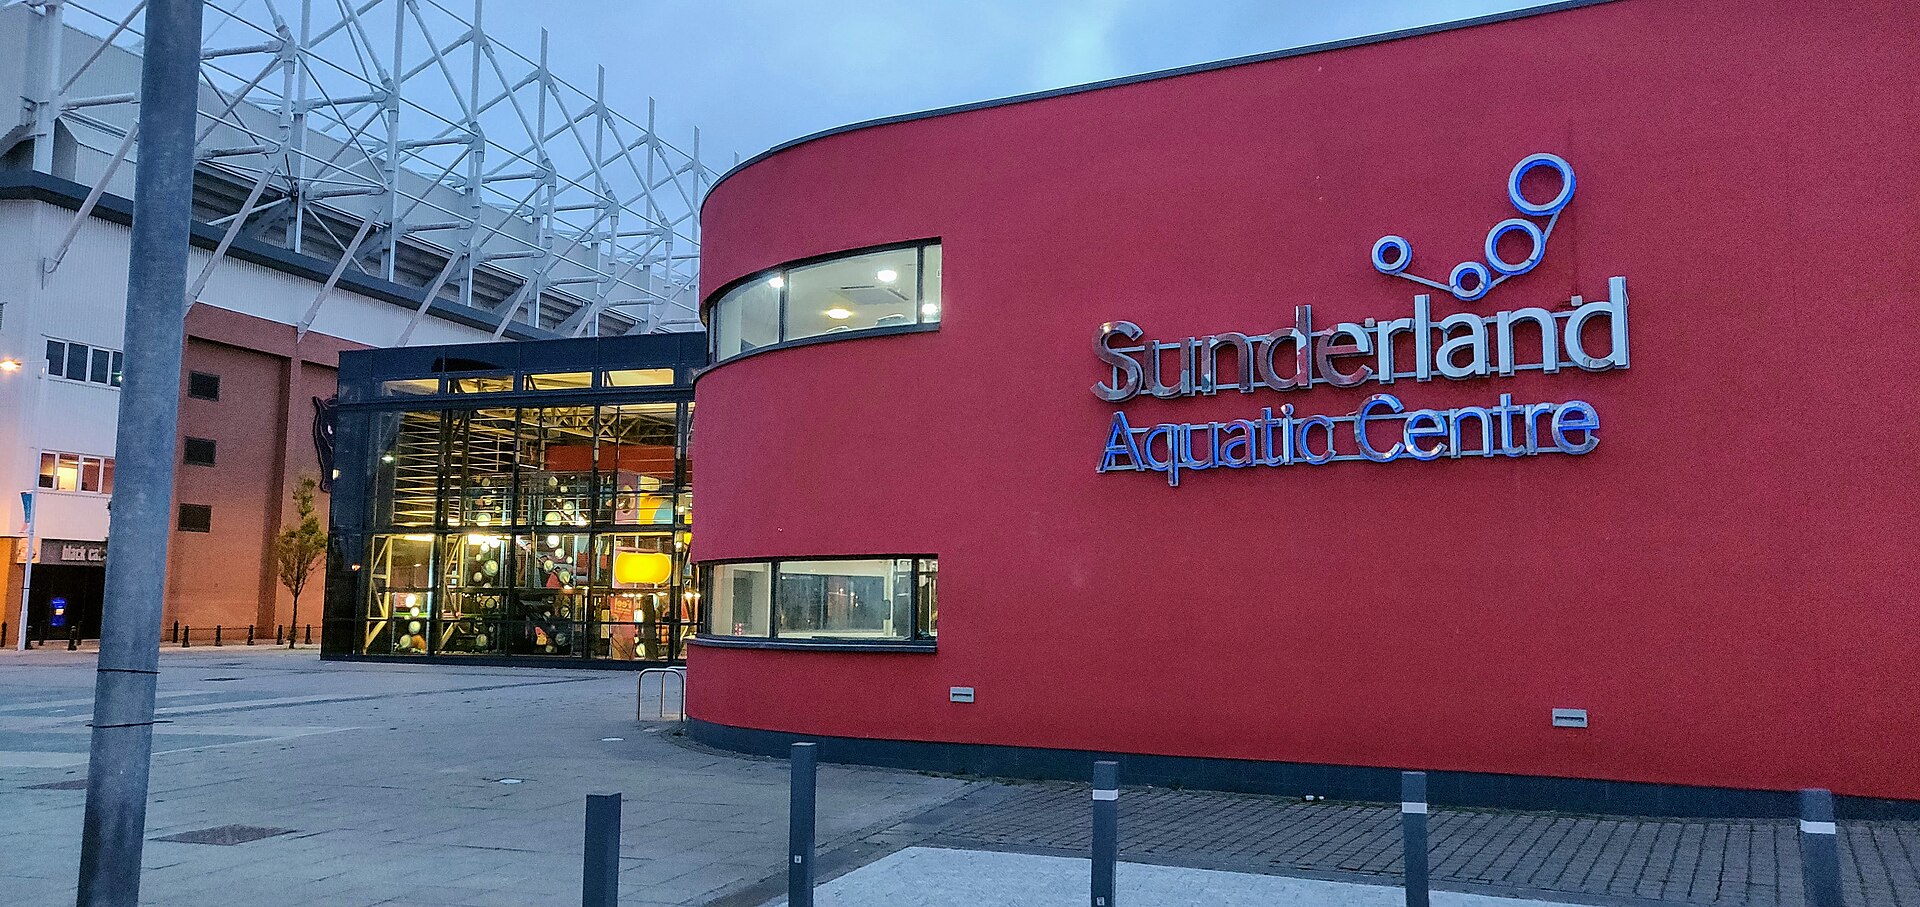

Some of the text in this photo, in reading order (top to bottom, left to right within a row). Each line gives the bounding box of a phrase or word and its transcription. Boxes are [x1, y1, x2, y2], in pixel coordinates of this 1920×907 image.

[1090, 276, 1630, 402] Sunderland
[1096, 393, 1600, 486] Aquatic Centre
[61, 544, 86, 561] black
